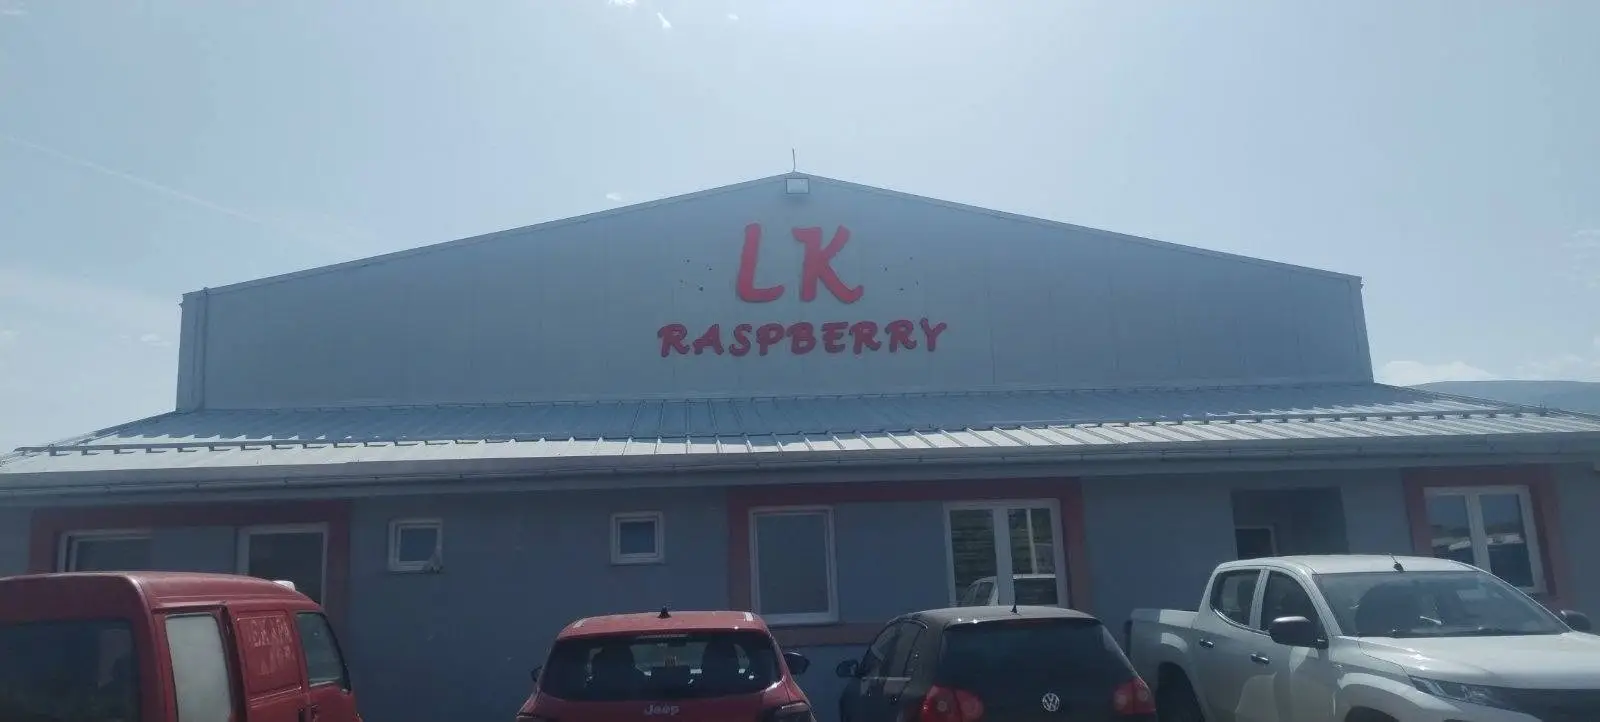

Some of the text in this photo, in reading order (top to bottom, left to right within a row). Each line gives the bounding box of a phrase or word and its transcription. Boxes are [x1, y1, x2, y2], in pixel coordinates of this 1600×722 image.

[736, 223, 864, 304] LK
[657, 318, 947, 357] RASPBERRY
[644, 704, 680, 716] Jeep
